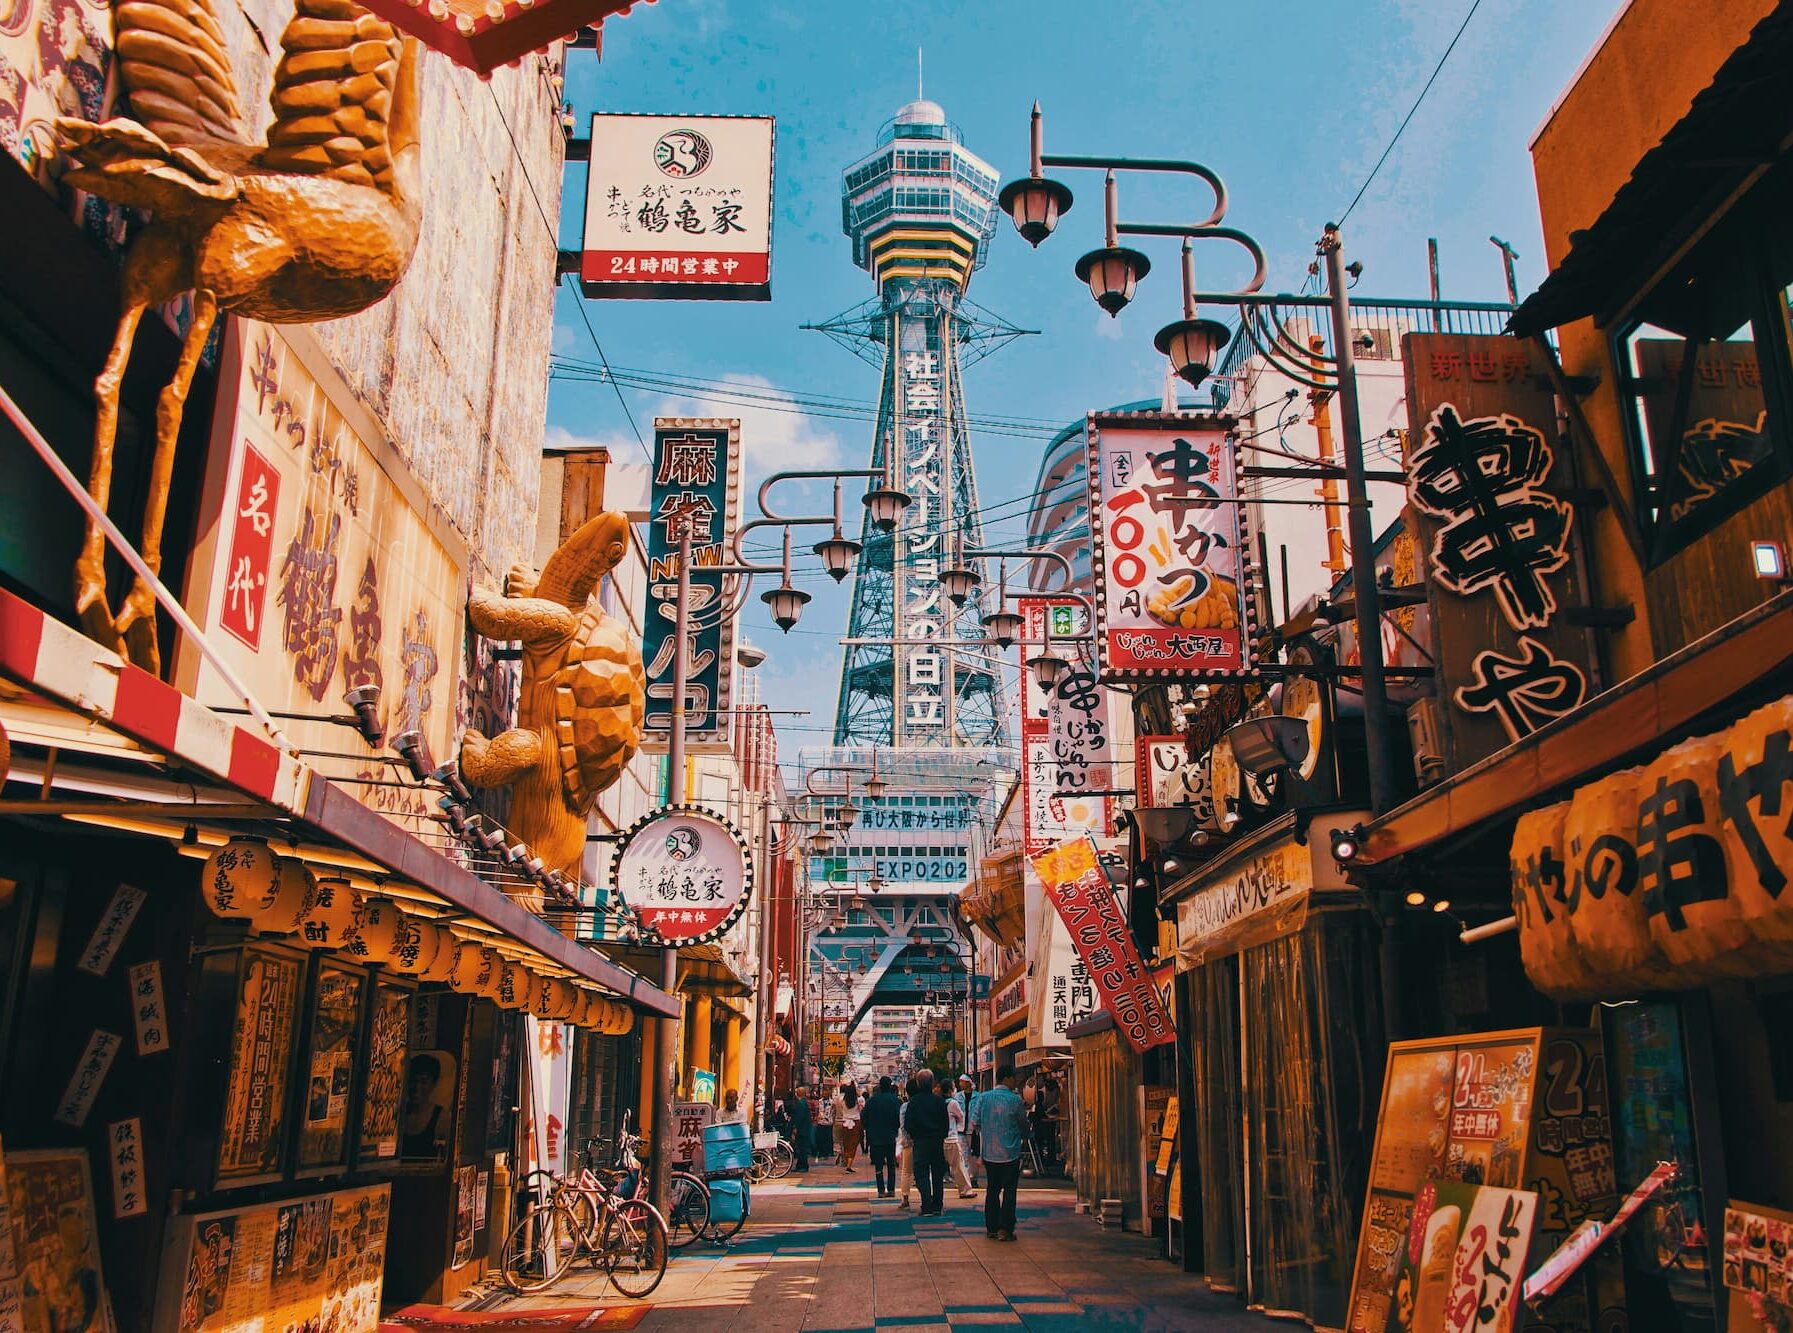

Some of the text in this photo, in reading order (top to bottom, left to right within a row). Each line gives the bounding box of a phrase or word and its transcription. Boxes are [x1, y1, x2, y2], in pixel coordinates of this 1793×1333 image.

[636, 197, 748, 236] 鶴亀家
[610, 256, 740, 276] 24時間営業中
[1431, 351, 1532, 386] 新世界
[1112, 455, 1131, 486] 全て
[905, 350, 942, 726] 社会イノベーションの日立
[1141, 437, 1229, 612] 串かつ
[228, 473, 272, 633] 名代
[650, 542, 724, 582] NW
[658, 874, 726, 901] 鶴亀家
[650, 910, 708, 924] 年中無休
